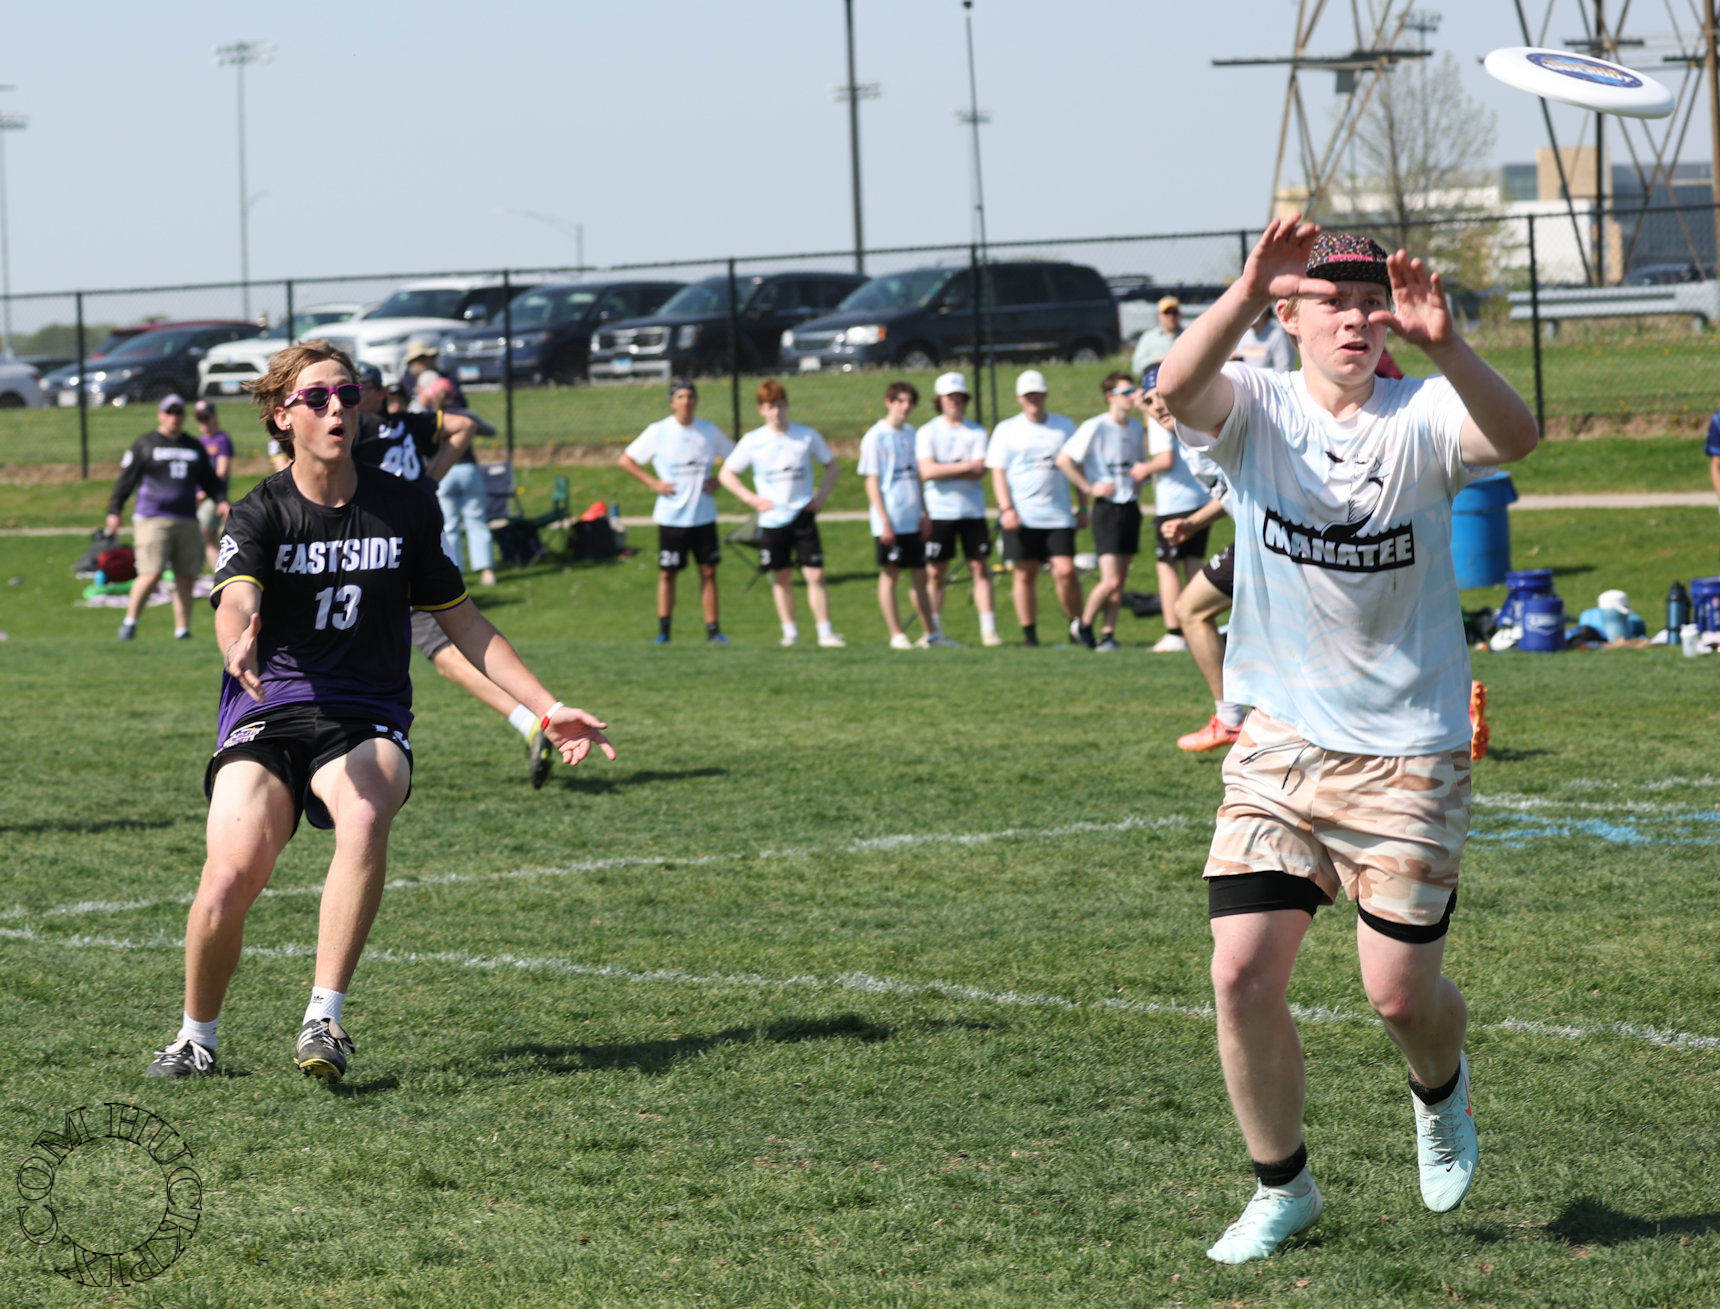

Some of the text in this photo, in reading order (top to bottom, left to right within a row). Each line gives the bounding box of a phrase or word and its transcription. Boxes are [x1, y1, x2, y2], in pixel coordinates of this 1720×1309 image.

[274, 536, 404, 575] EASTSIDE
[1265, 517, 1412, 568] MANATEE
[314, 584, 363, 631] 13
